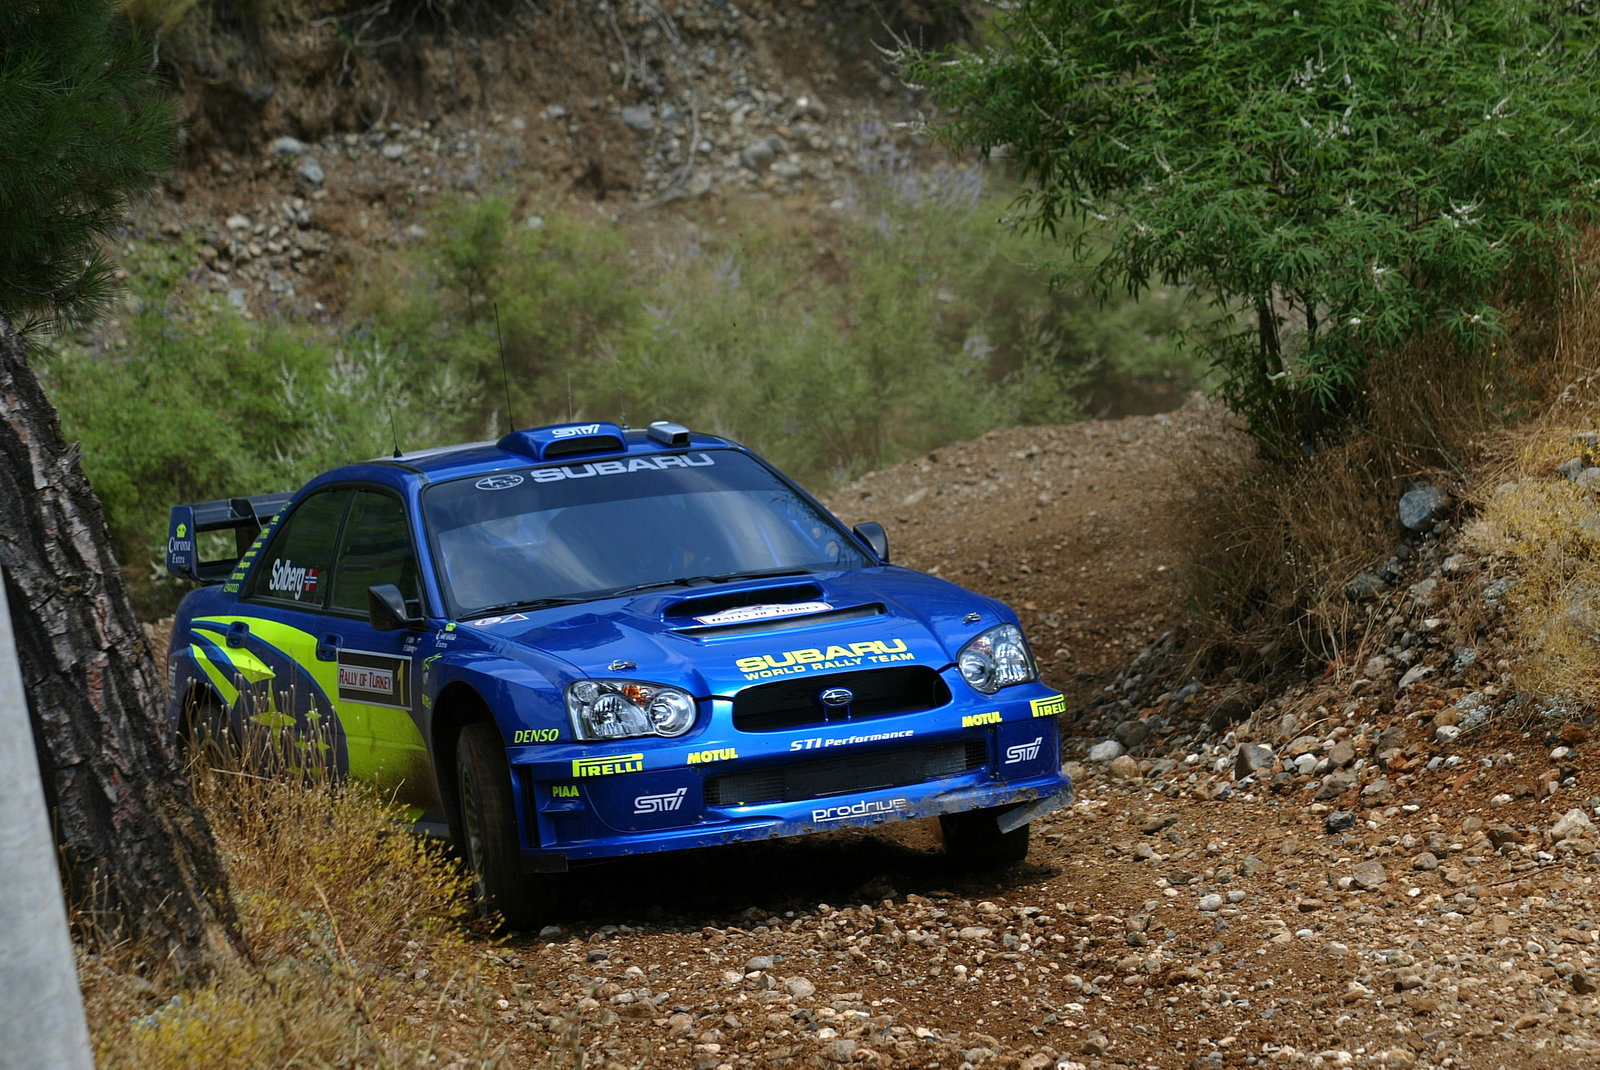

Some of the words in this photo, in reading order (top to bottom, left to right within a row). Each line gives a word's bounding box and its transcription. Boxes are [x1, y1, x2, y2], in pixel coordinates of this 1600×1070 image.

[530, 453, 715, 483] SUBARU
[168, 536, 191, 553] Corona
[269, 558, 306, 600] Solberg
[736, 638, 908, 673] SUBARU
[744, 664, 806, 681] WORLD
[814, 656, 862, 671] RALLY
[871, 652, 915, 664] TEAM
[339, 668, 359, 686] RALLY
[369, 671, 391, 690] TURKEY
[397, 660, 405, 706] 1
[962, 712, 1002, 727] MOTUL
[514, 728, 559, 744] DENSO
[790, 738, 822, 751] STI
[824, 730, 914, 748] Performance
[572, 753, 644, 777] PIRELLI
[687, 748, 738, 764] MOTUL
[552, 785, 579, 797] PIAA
[812, 798, 907, 823] prodrive
